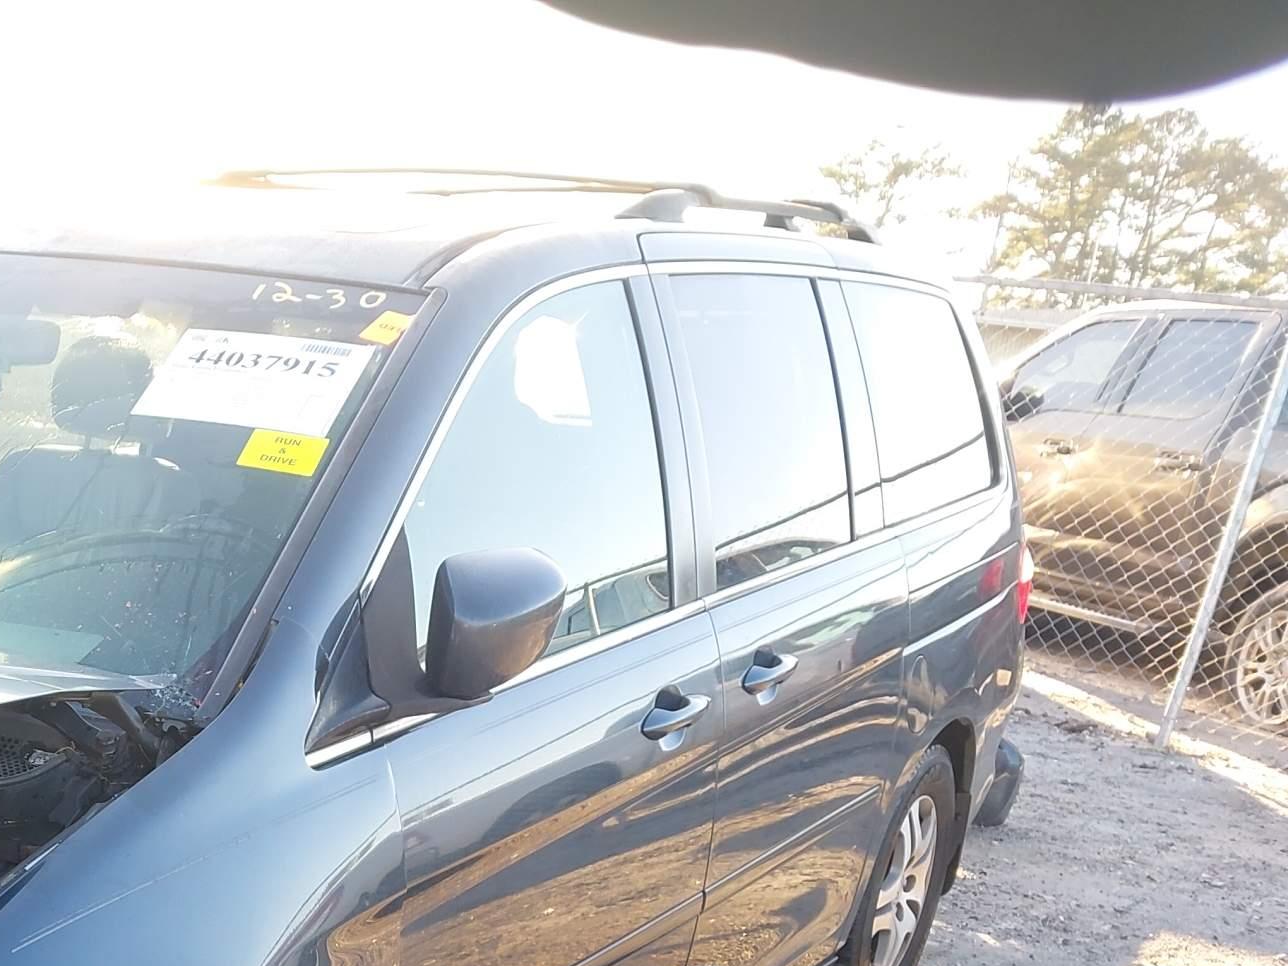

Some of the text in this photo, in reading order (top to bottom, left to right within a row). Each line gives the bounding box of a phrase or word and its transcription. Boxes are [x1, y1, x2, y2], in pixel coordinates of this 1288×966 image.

[188, 348, 340, 378] 44037915
[274, 436, 303, 447] RUN
[259, 453, 298, 466] DRIVE
